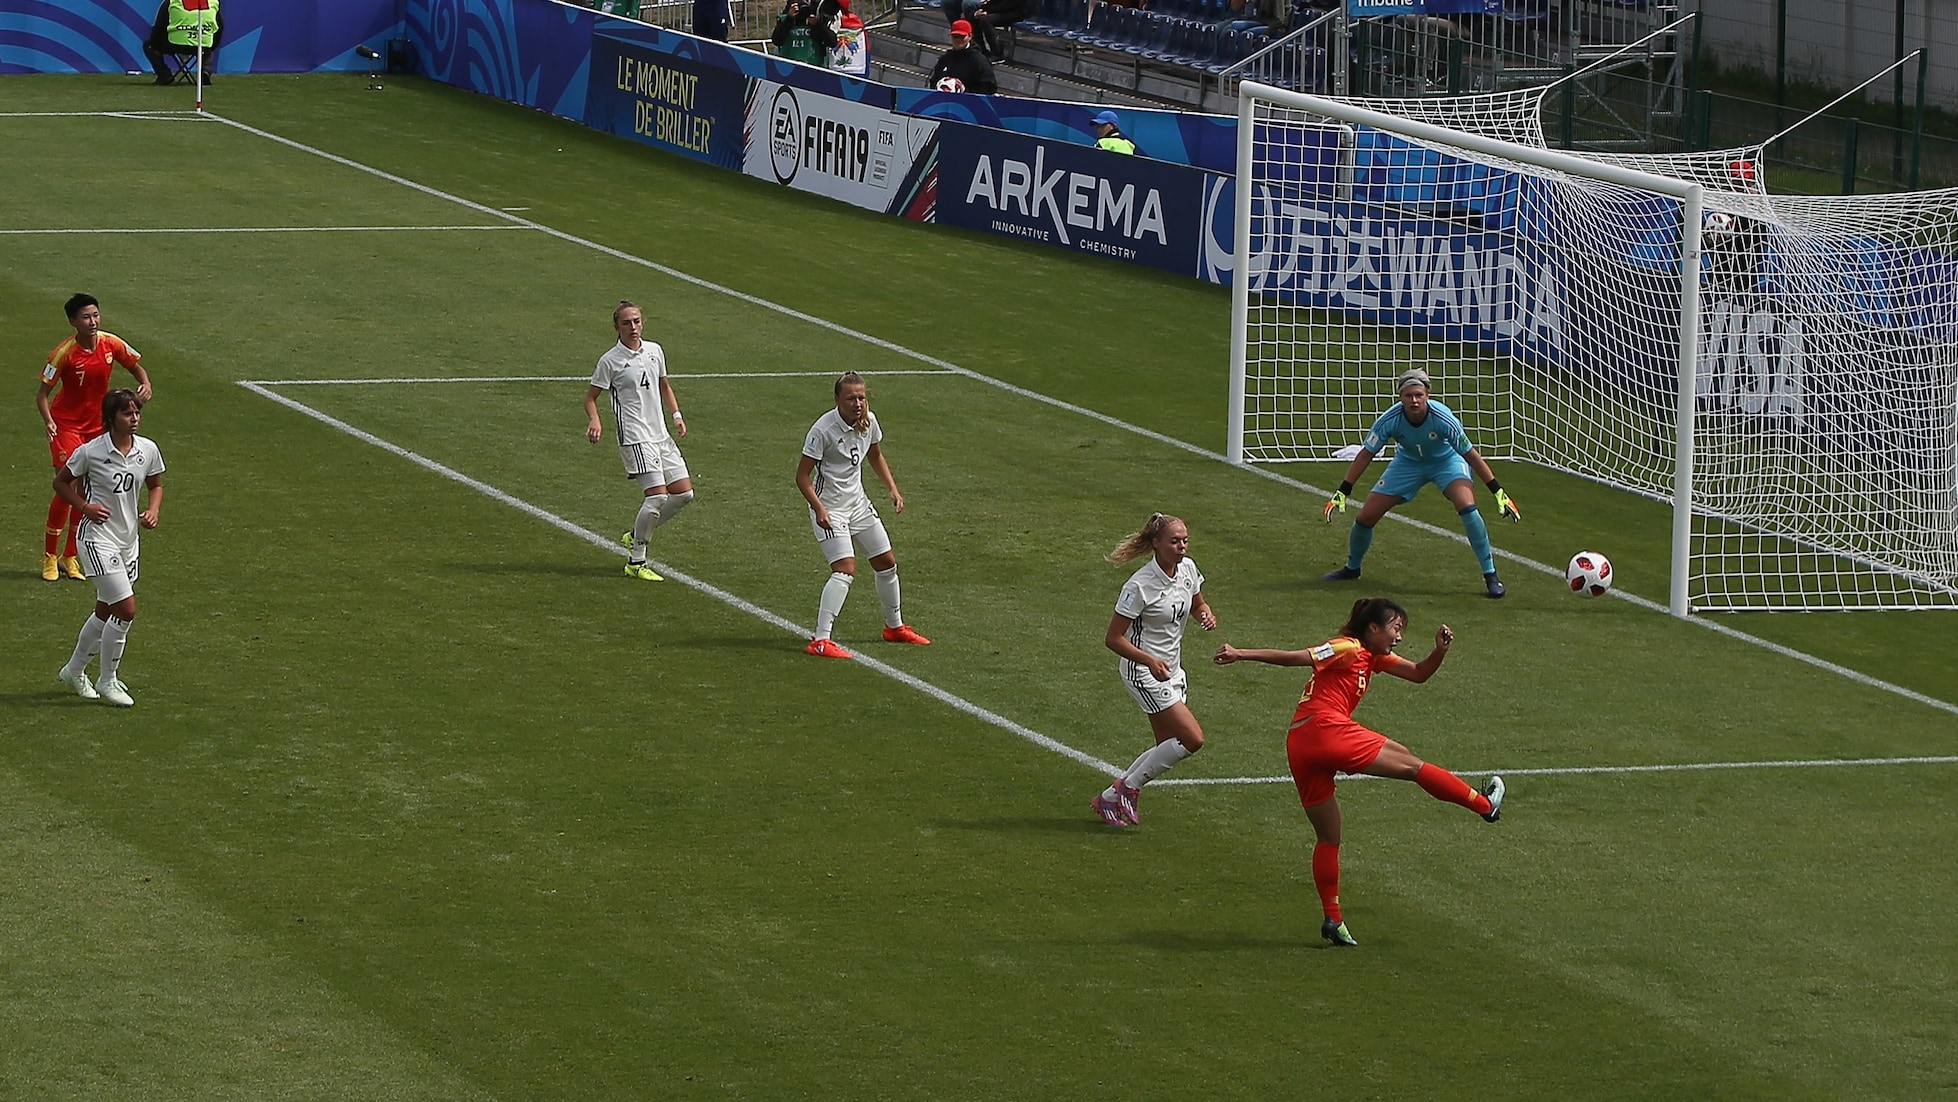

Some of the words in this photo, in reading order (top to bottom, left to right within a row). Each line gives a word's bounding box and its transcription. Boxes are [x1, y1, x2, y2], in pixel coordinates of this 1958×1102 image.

[617, 55, 633, 92] LE
[635, 60, 699, 111] MOMENT
[635, 99, 654, 137] DE
[774, 107, 796, 140] EA
[878, 130, 894, 147] FIFA
[773, 140, 796, 160] SPORTS
[966, 145, 1168, 246] ARKEMA
[991, 219, 1050, 242] INNOVATIVE
[1079, 238, 1138, 261] CHEMISTRY
[1386, 226, 1562, 348] WANDA
[76, 370, 86, 386] 7
[640, 371, 650, 390] 4
[1415, 444, 1423, 457] 1
[112, 472, 135, 494] 20
[1171, 601, 1186, 623] 14
